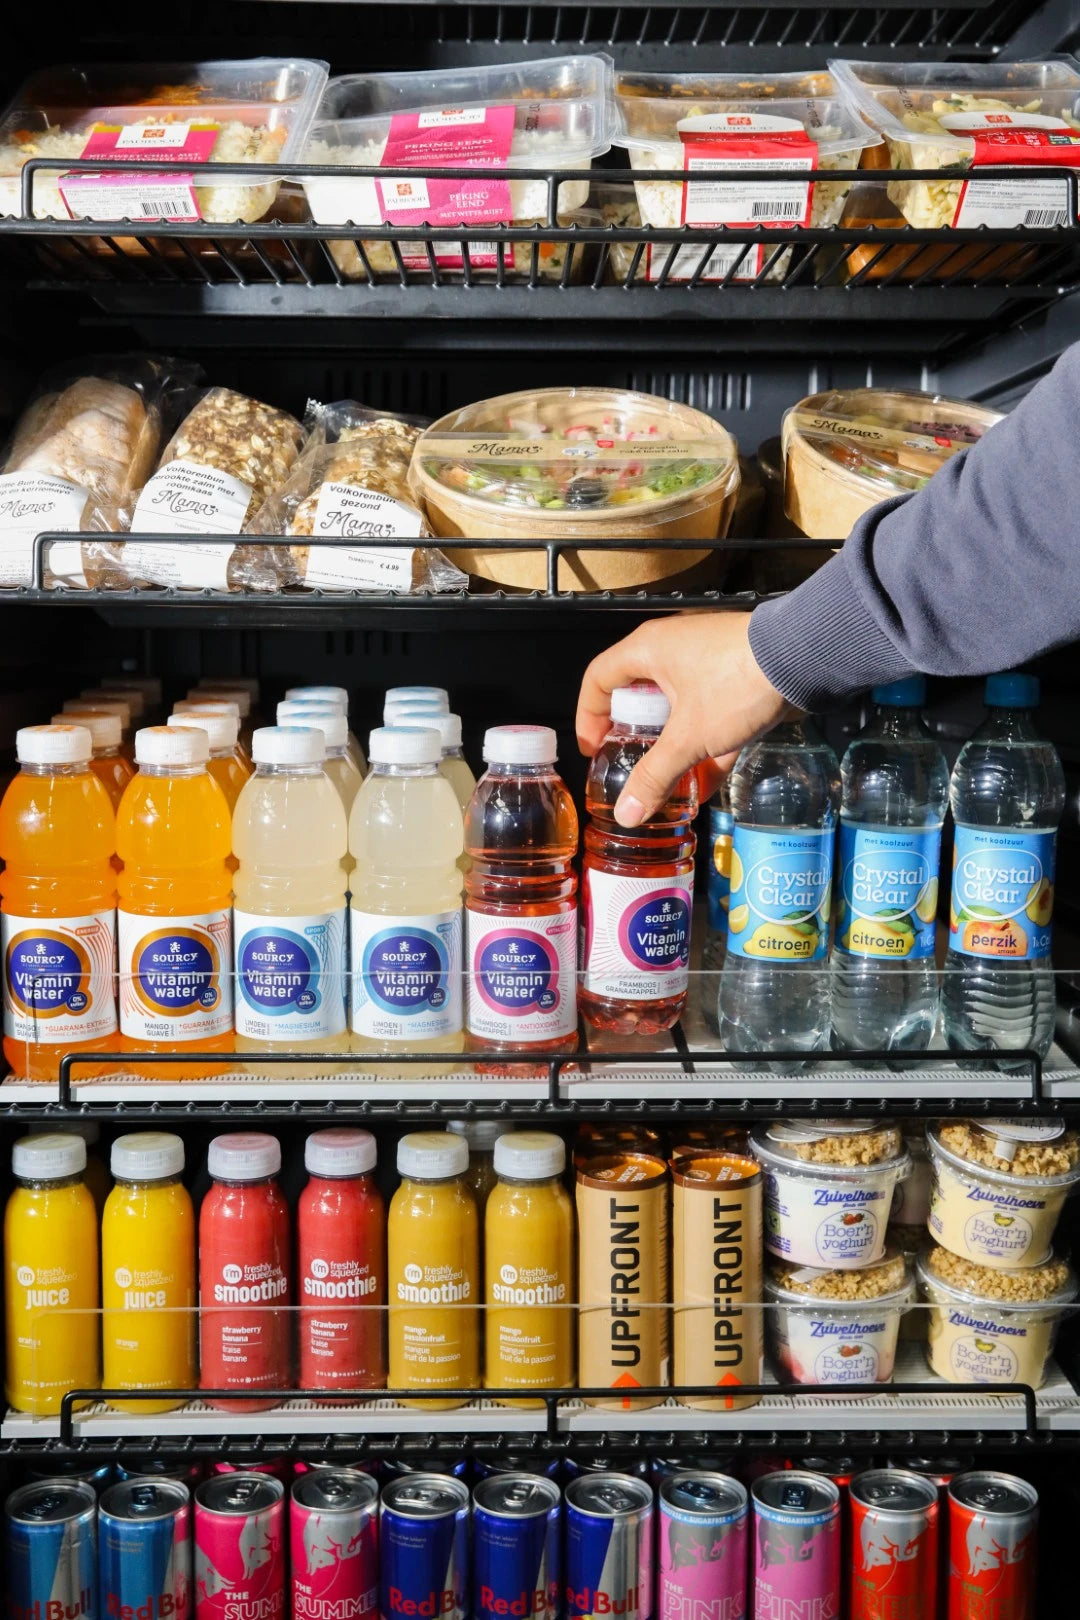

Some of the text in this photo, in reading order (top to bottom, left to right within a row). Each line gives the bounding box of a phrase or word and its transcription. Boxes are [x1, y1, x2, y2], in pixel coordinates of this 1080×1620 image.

[404, 138, 493, 150] PEKING EEND
[448, 192, 488, 202] PEKING
[456, 200, 484, 208] EEND
[166, 466, 225, 485] Volkorenbun
[166, 482, 214, 496] roomkaas
[193, 480, 236, 497] zalm met
[330, 485, 397, 504] Volkorenbun
[340, 498, 382, 511] gezond
[770, 840, 786, 848] met
[990, 838, 1024, 846] koolzuur
[758, 866, 828, 890] Crystal
[853, 863, 923, 886] Crystal
[964, 860, 1036, 886] Crystal
[758, 887, 814, 906] Clear
[852, 882, 908, 904] Clear
[964, 882, 1019, 904] Clear
[645, 911, 683, 923] SOURCY
[636, 930, 686, 946] Vitamin
[758, 936, 810, 950] citroen
[852, 932, 904, 948] citroen
[972, 933, 1017, 948] perzik
[152, 952, 198, 962] SOURCY
[252, 952, 294, 962] SOURCY
[382, 952, 427, 962] SOURCY
[645, 943, 680, 957] water
[20, 955, 64, 964] SOURCY
[492, 954, 536, 963] SOURCY
[16, 972, 72, 988] Vitamin
[146, 970, 204, 986] Vitamin
[247, 969, 302, 986] Vitamin
[375, 970, 434, 984] Vitamin
[486, 970, 542, 986] Vitamin
[619, 980, 657, 988] FRAMBOOS
[22, 987, 64, 1000] water
[154, 986, 197, 998] water
[253, 986, 293, 998] water
[384, 986, 426, 997] water
[494, 987, 535, 998] water
[606, 985, 658, 995] GRANAATAPPEL
[144, 1022, 170, 1030] MANGO
[974, 1219, 1028, 1239] Boer'n
[970, 1231, 1028, 1250] yoghurt
[244, 1263, 272, 1274] freshly
[330, 1260, 360, 1270] freshly
[330, 1264, 369, 1278] squeezed
[424, 1266, 453, 1275] freshly
[520, 1266, 548, 1278] freshly
[244, 1266, 282, 1282] squeezed
[424, 1270, 463, 1284] squeezed
[520, 1272, 558, 1286] squeezed
[304, 1276, 377, 1298] smoothie
[610, 1197, 641, 1367] UPFRONT
[714, 1197, 743, 1367] UPFRONT
[214, 1276, 288, 1304] smoothie
[398, 1281, 470, 1304] smoothie
[493, 1283, 566, 1306] smoothie
[26, 1288, 70, 1310] juice
[124, 1290, 166, 1310] juice
[222, 1326, 262, 1334] strawberry
[311, 1320, 348, 1330] strawberry
[404, 1326, 426, 1336] mango
[500, 1326, 522, 1336] mango
[810, 1321, 886, 1338] Zuivelhoeve
[222, 1334, 248, 1342] banana
[311, 1328, 335, 1338] banana
[222, 1354, 248, 1362] banane
[404, 1352, 418, 1362] fruit
[418, 1354, 427, 1363] de
[428, 1354, 435, 1363] la
[500, 1352, 513, 1362] fruit
[514, 1354, 522, 1364] de
[523, 1354, 530, 1364] la
[956, 1343, 1012, 1367] Boer'n
[822, 1356, 874, 1369] Boer'n
[956, 1358, 1012, 1378] yoghurt
[821, 1369, 874, 1382] yoghurt
[688, 1516, 727, 1524] SUGARFREE
[294, 1580, 312, 1595] THE
[664, 1579, 684, 1595] THE
[755, 1577, 773, 1593] THE
[224, 1592, 249, 1600] THE
[389, 1586, 436, 1616] Red
[481, 1585, 527, 1616] Red
[593, 1587, 638, 1614] Bull
[46, 1588, 91, 1620] Bull
[108, 1592, 153, 1620] Red
[664, 1591, 744, 1620] PINK
[755, 1588, 834, 1620] PINK
